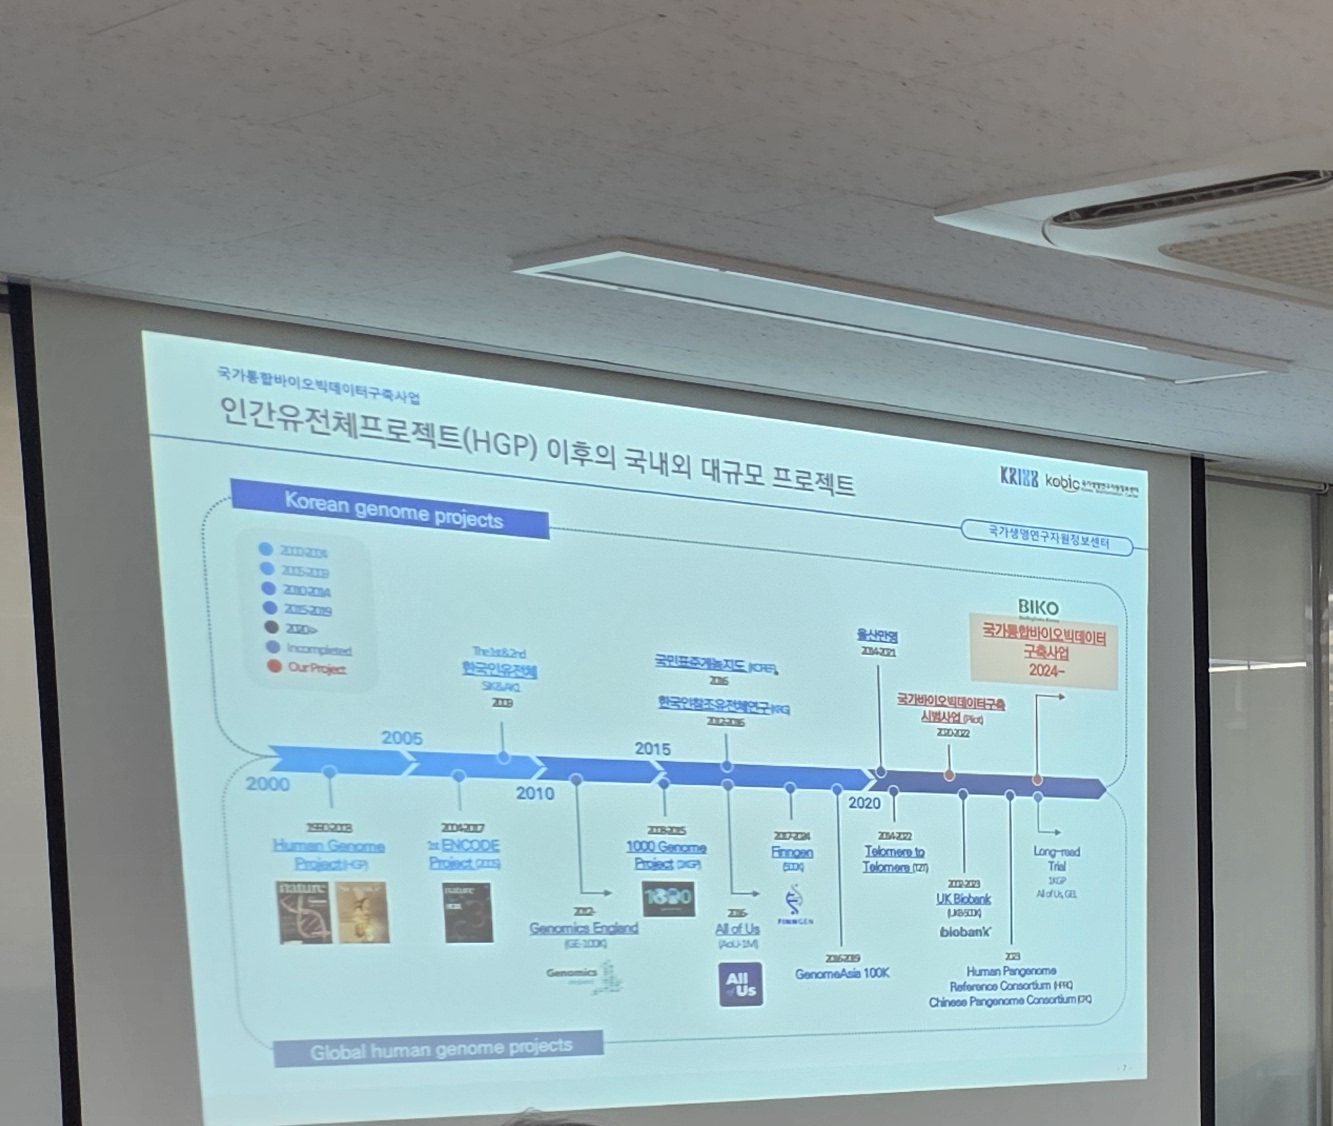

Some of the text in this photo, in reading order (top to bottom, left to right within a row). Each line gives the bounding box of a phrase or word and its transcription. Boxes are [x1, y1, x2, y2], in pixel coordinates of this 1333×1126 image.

[217, 365, 421, 406] 국가통합바이오빅데이터구축사업
[220, 396, 857, 497] 인간유전체프로젝트(HGP) 이후의 국내외 대규모 프로젝트
[284, 490, 505, 530] Korean genome projects
[988, 524, 1110, 550] 국가생명연구자원정보센터
[1019, 598, 1060, 616] BIKO
[983, 622, 1107, 646] 국가통합바이오빅데이터
[1024, 644, 1069, 661] 구축사업
[382, 731, 423, 745] 2005
[635, 742, 671, 756] 2015
[246, 777, 290, 791] 2000
[516, 787, 555, 800] 2010
[849, 796, 881, 809] 2020
[273, 839, 386, 853] Human Genome
[442, 839, 500, 852] ENCODE
[626, 840, 708, 854] 1000 Genome
[865, 844, 926, 858] Telomere to
[1034, 845, 1081, 858] Long-read
[294, 856, 344, 871] Project
[429, 856, 473, 871] Project
[634, 857, 675, 871] Project
[862, 860, 911, 873] Telomere
[1048, 860, 1067, 871] Trial
[280, 883, 327, 894] nature
[936, 892, 992, 905] UK Biobank
[529, 921, 639, 935] Genomics England
[715, 922, 760, 935] All of Us
[546, 968, 598, 978] Genomics
[725, 972, 748, 986] All
[795, 966, 890, 980] GenomeAsia 100K
[966, 965, 1057, 979] Human Pangenome
[736, 984, 757, 997] Us
[950, 980, 998, 992] Reference
[1000, 979, 1051, 991] Consortium
[929, 997, 968, 1008] Chinese
[969, 996, 1025, 1009] Pangenome
[1026, 994, 1077, 1006] Consortium
[310, 1037, 574, 1061] Global human genome projects
